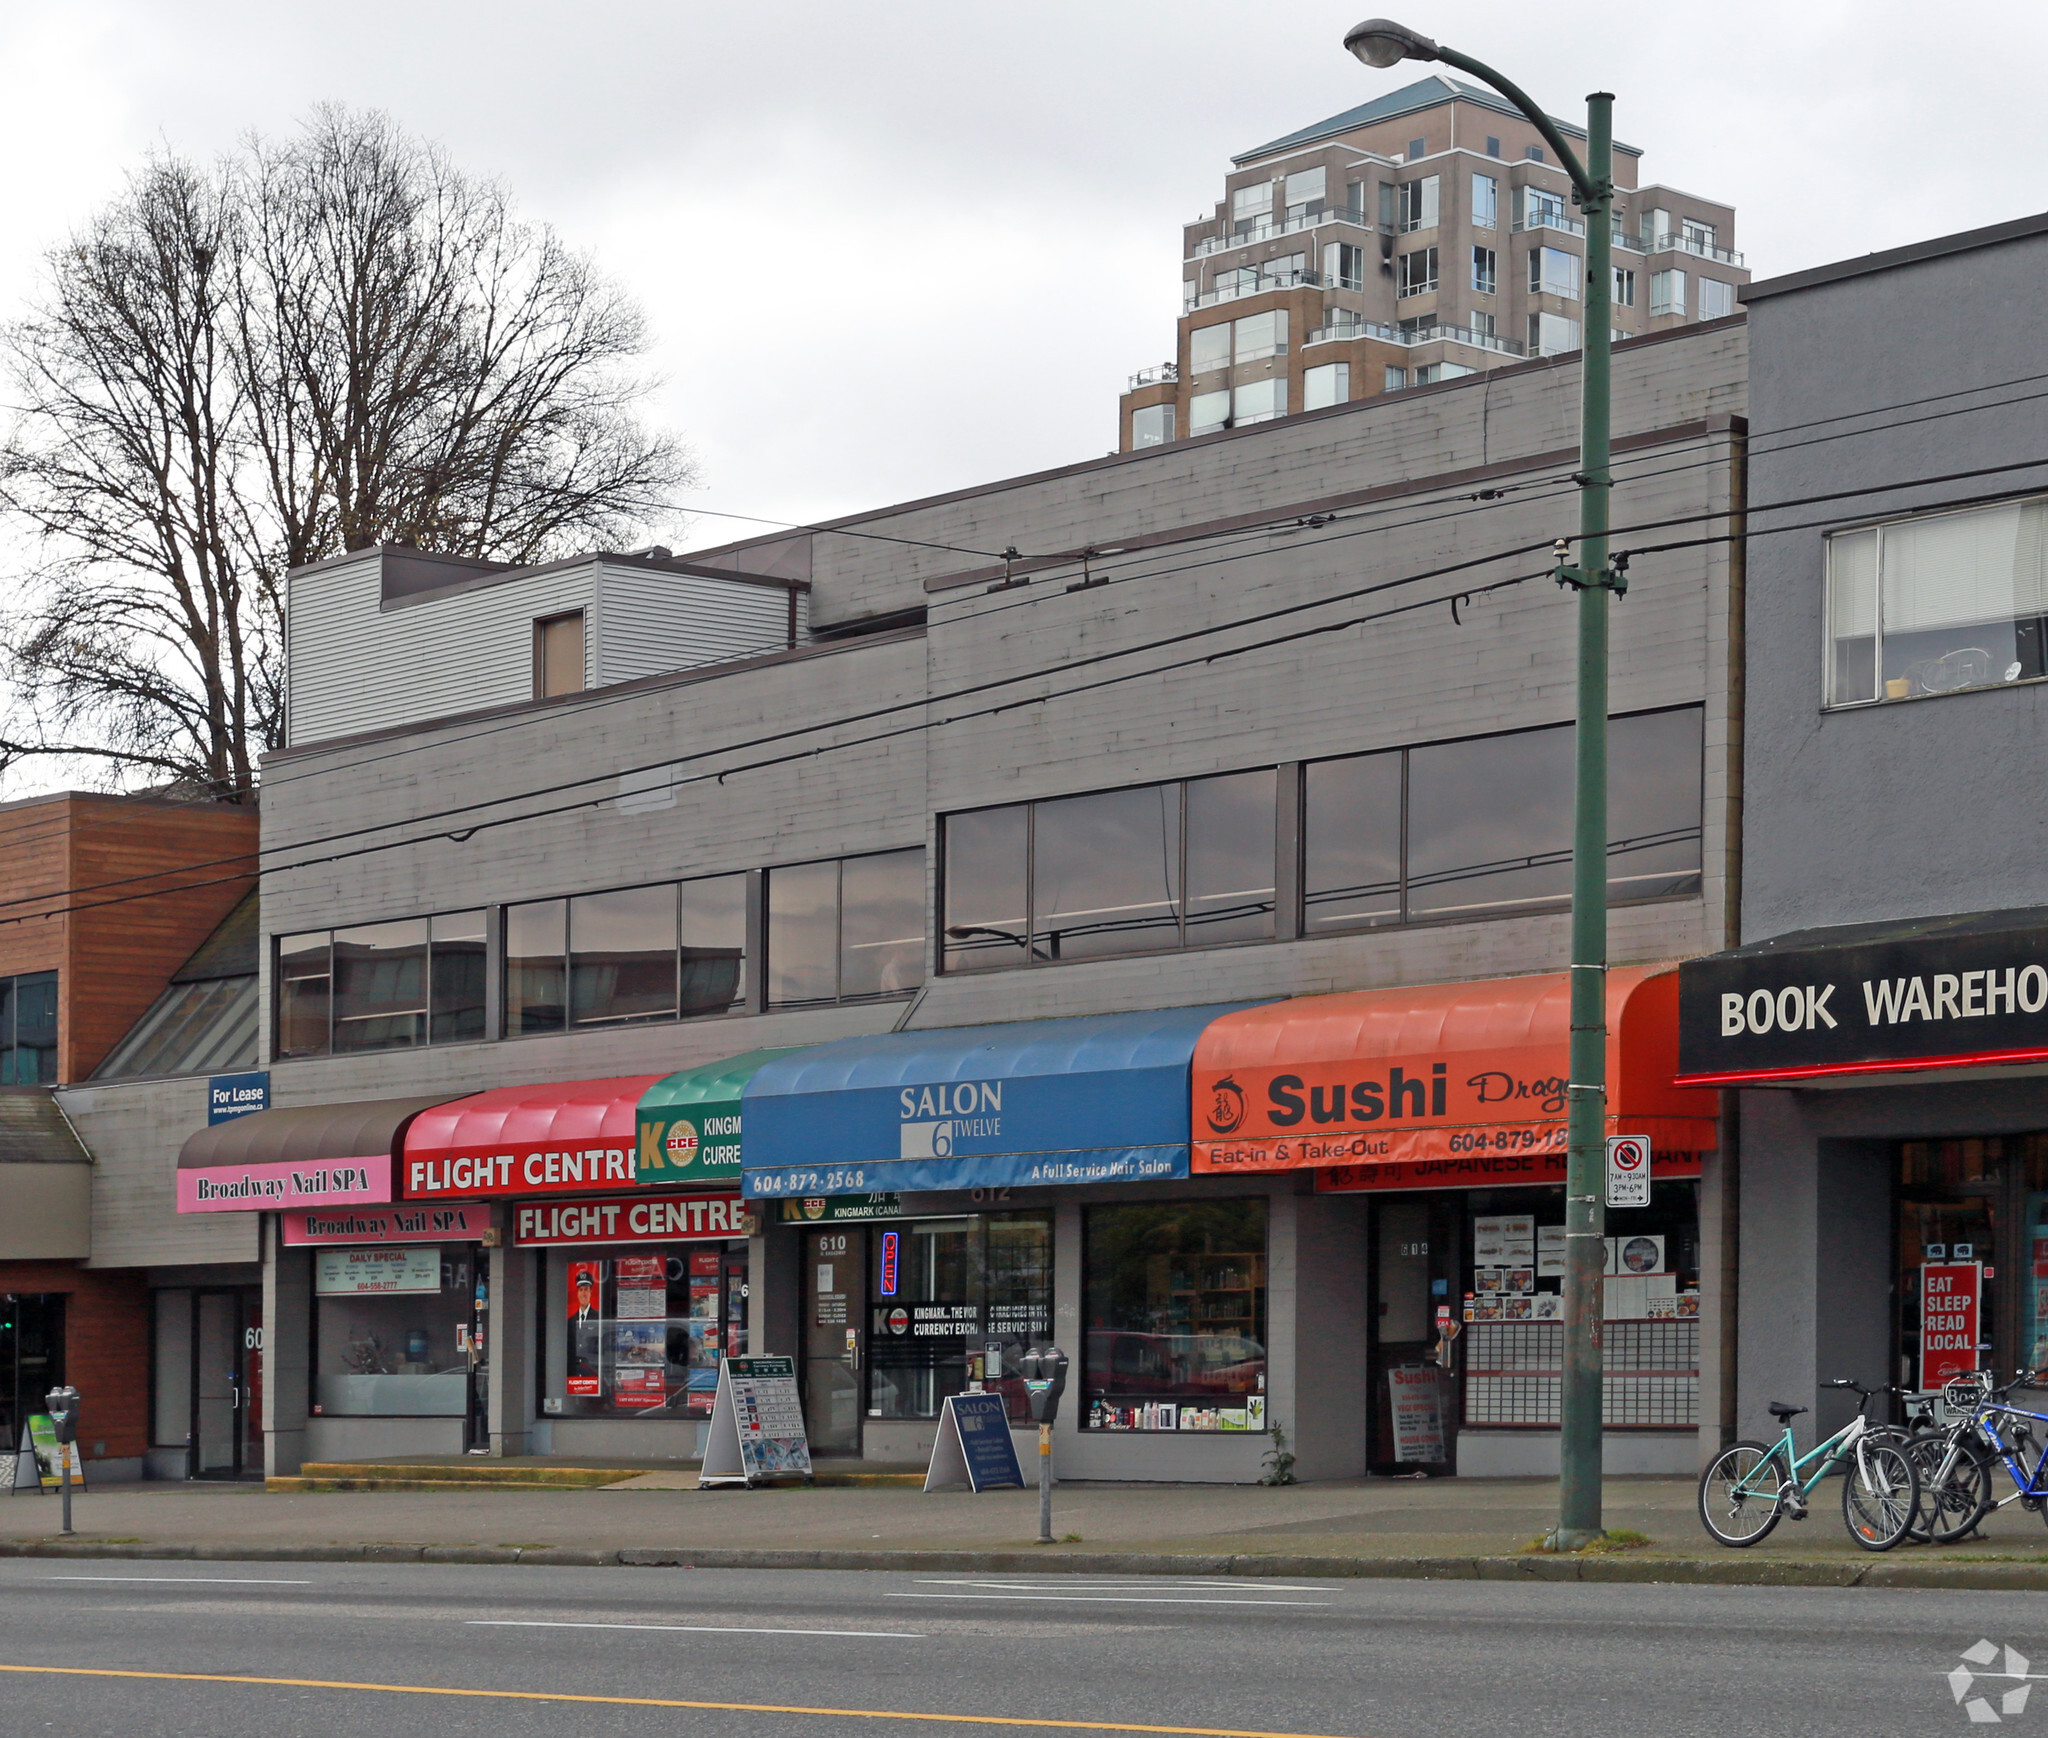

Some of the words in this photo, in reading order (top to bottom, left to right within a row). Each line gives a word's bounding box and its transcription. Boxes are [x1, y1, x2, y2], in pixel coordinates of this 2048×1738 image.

[1721, 983, 1838, 1037] BOOK
[1862, 964, 2048, 1026] WAREHO
[213, 1089, 230, 1103] For
[233, 1087, 263, 1102] Lease
[900, 1081, 1001, 1119] SALON
[1267, 1063, 1446, 1127] Sushi
[1467, 1072, 1569, 1113] Drag
[932, 1121, 951, 1158] 6
[953, 1118, 1000, 1137] TWELVE
[1450, 1128, 1568, 1152] 604-879-18
[1210, 1148, 1266, 1164] Eat-in
[1275, 1144, 1289, 1160] &
[1299, 1140, 1389, 1159] Take-Out
[410, 1155, 514, 1191] FLIGHT
[1032, 1166, 1039, 1179] A
[1043, 1164, 1063, 1178] Full
[1066, 1163, 1107, 1177] Service
[1109, 1161, 1135, 1175] Hair
[1138, 1159, 1172, 1174] Salon
[197, 1175, 287, 1201] Broadway
[291, 1170, 327, 1195] Nail
[332, 1168, 369, 1191] SPA
[519, 1204, 621, 1238] FLIGHT
[628, 1200, 745, 1234] CENTRE
[834, 1207, 874, 1218] KINGMARK
[875, 1206, 901, 1216] (CANA
[306, 1215, 388, 1238] Broadway
[394, 1212, 426, 1233] Nail
[433, 1210, 467, 1232] SPA
[820, 1235, 846, 1251] 610
[350, 1254, 372, 1263] DAILY
[374, 1252, 407, 1262] SPECIAL
[884, 1234, 896, 1292] OPEN
[1927, 1277, 1953, 1293] EAT
[1927, 1295, 1972, 1312] SLEEP
[951, 1307, 963, 1319] THE
[914, 1323, 954, 1336] CURRENCY
[1927, 1315, 1965, 1331] READ
[1927, 1333, 1972, 1350] LOCAL
[1395, 1370, 1437, 1384] Sushi
[957, 1401, 1000, 1415] SALON
